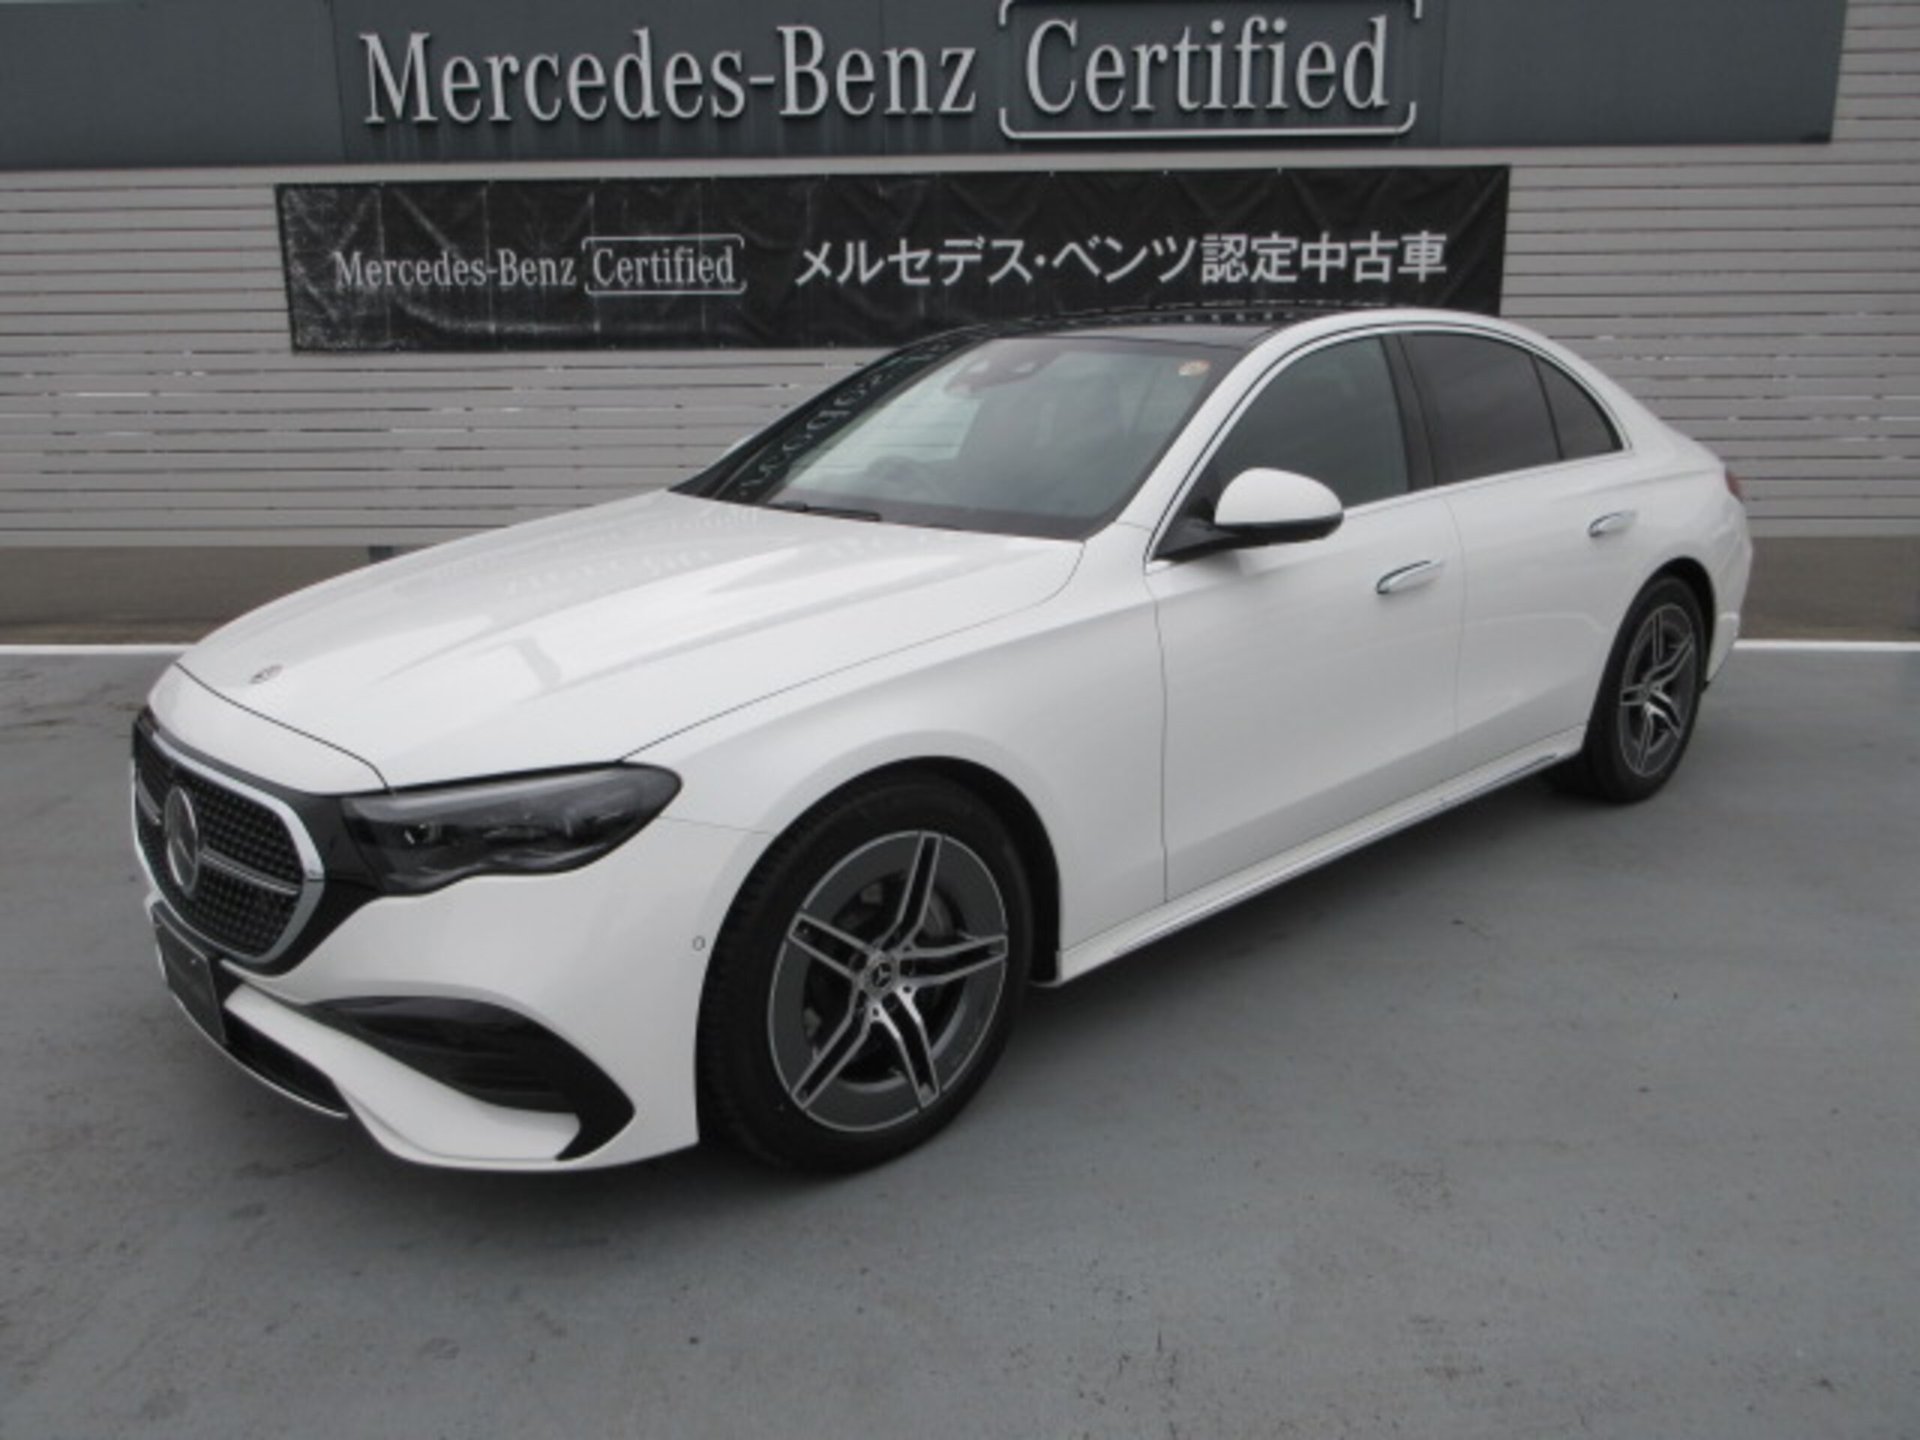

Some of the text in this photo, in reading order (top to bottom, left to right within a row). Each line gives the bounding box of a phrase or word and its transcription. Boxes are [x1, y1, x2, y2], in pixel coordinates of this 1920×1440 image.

[360, 15, 1389, 125] Mercedes-Benz Certified
[334, 245, 736, 288] Mercedes-Benz Certified
[795, 231, 1448, 286] メルセデス・ベンツ認定中古車
